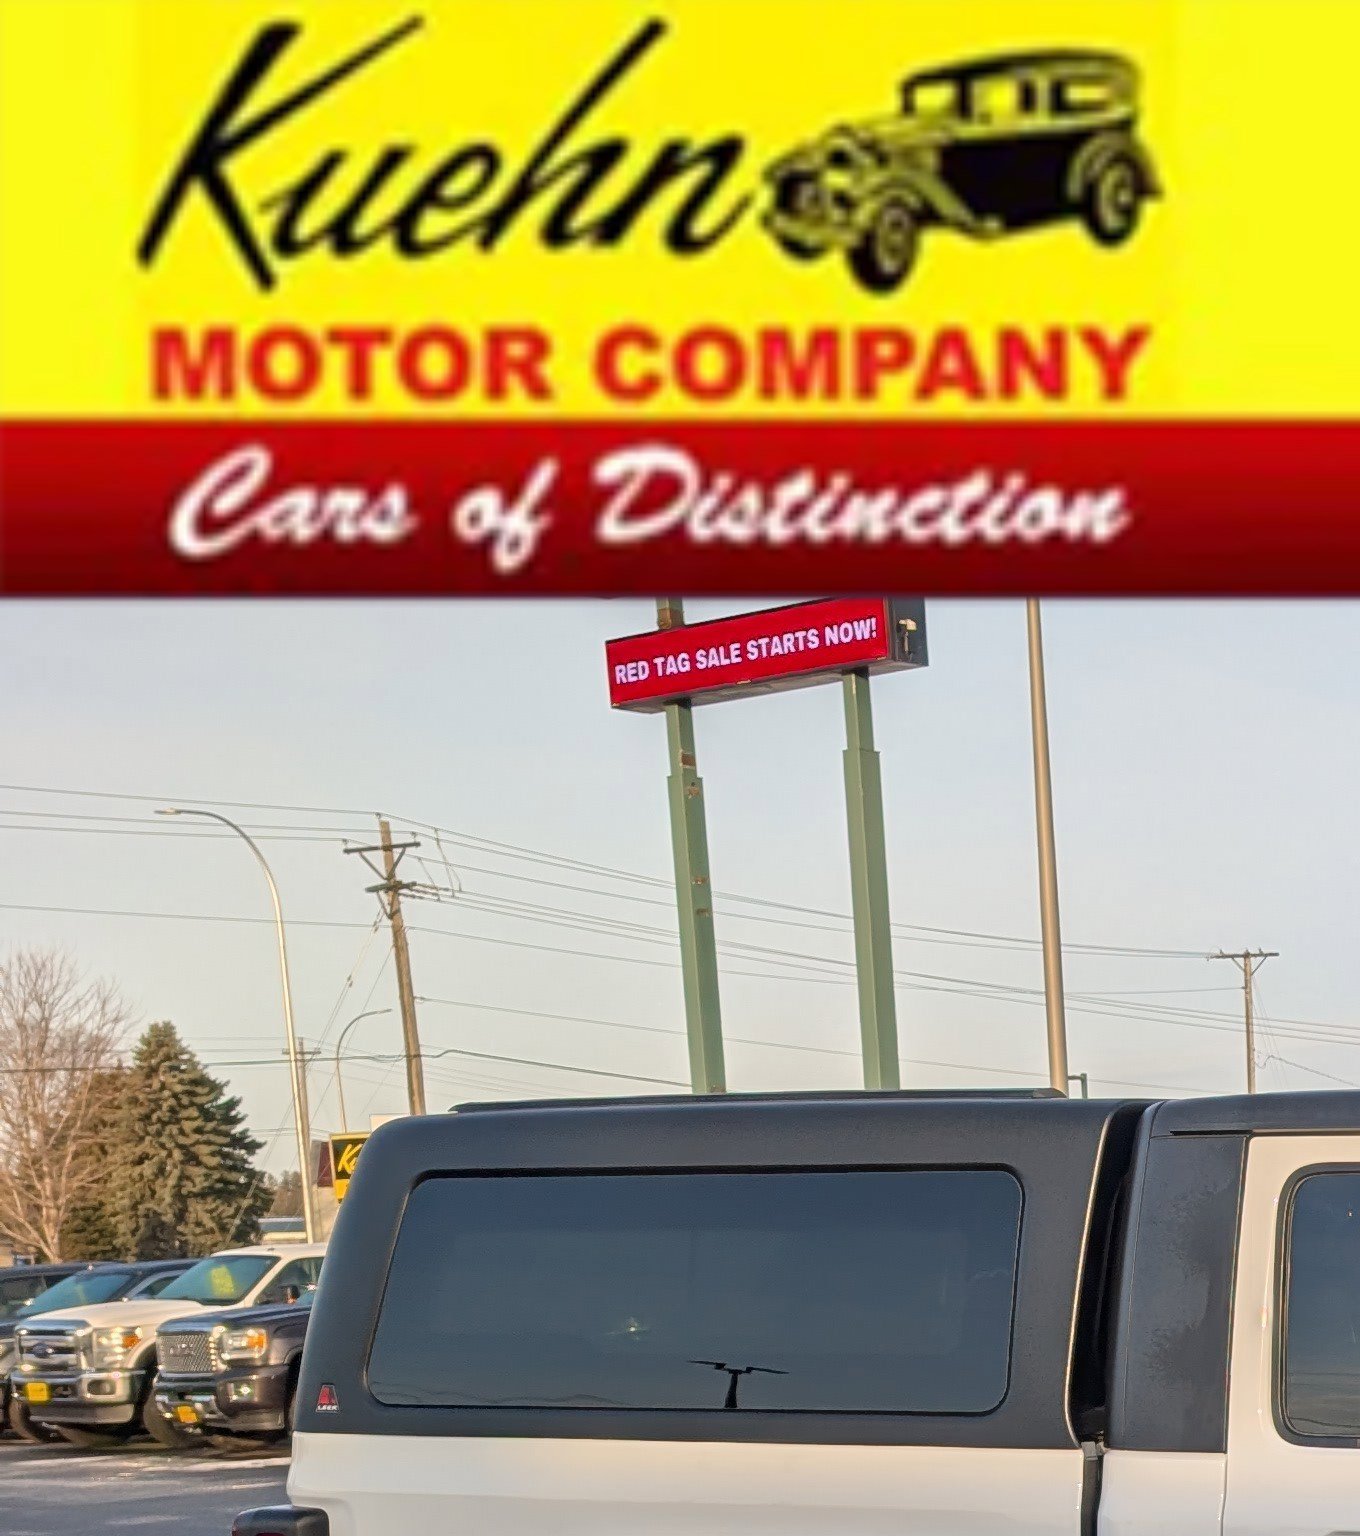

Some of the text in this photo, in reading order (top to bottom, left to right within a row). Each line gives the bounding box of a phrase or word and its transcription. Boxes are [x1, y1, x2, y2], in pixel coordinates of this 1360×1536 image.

[614, 617, 877, 685] RED TAG SALE STARTS NOW!
